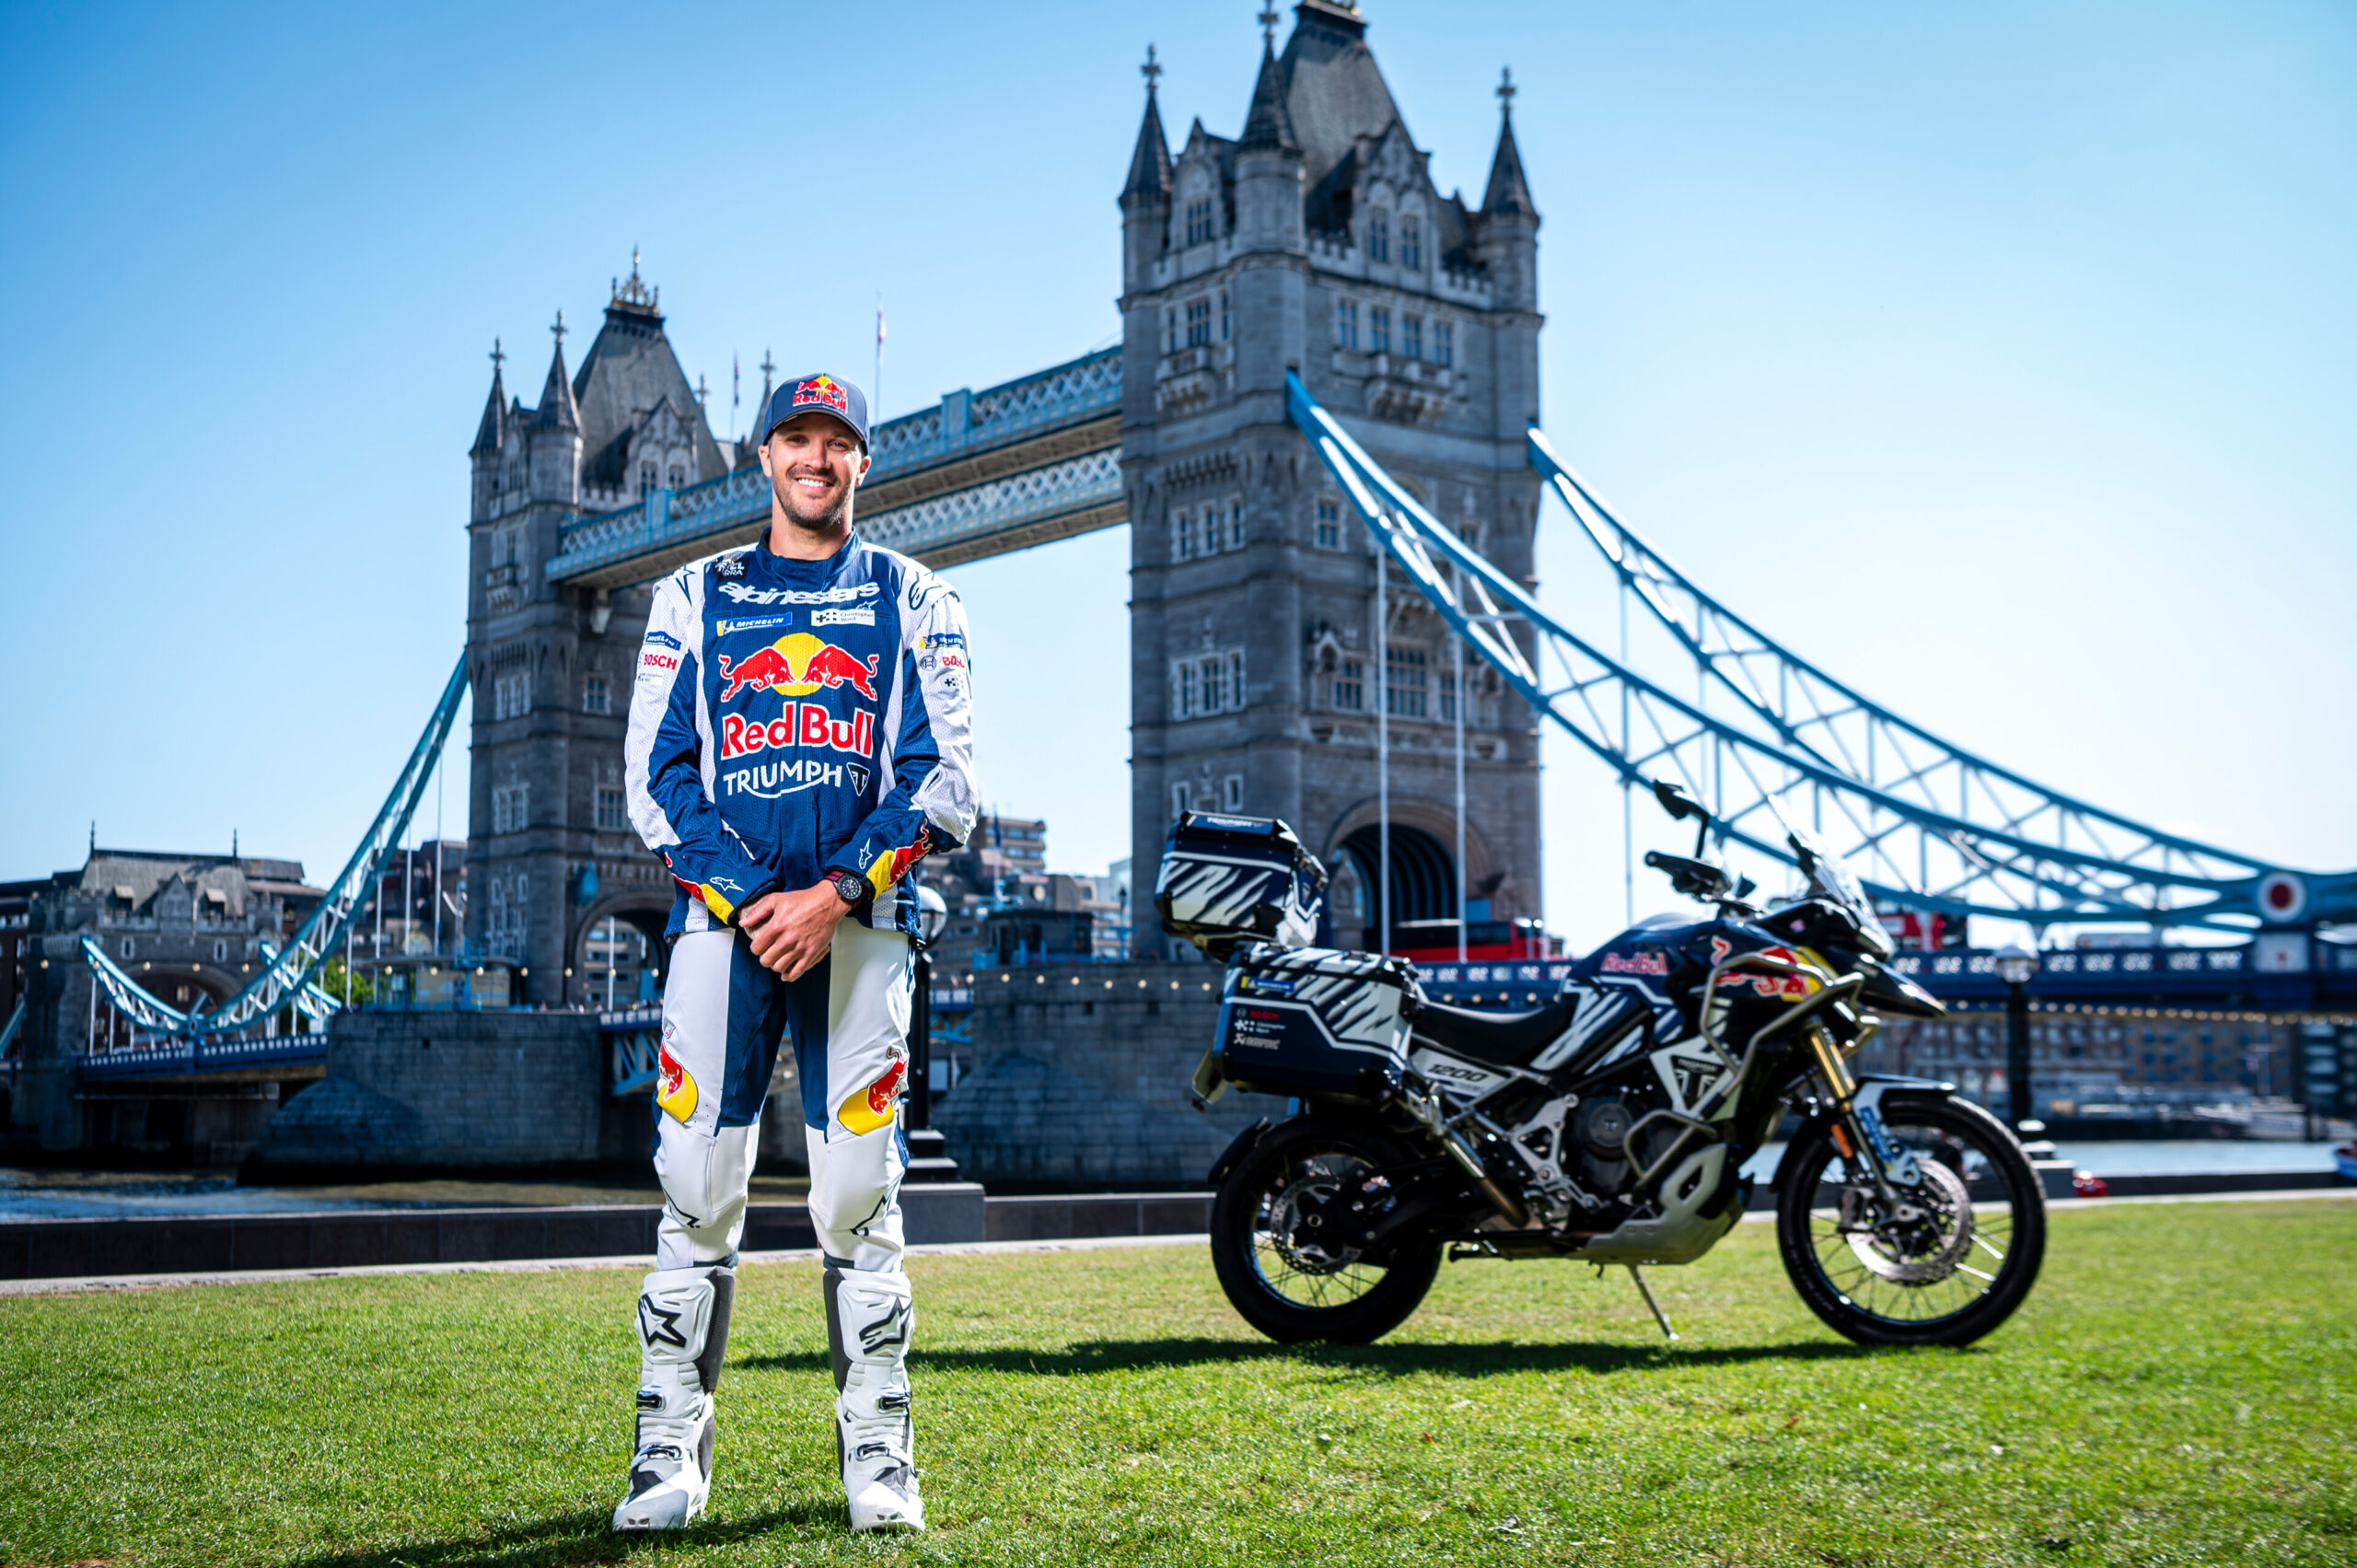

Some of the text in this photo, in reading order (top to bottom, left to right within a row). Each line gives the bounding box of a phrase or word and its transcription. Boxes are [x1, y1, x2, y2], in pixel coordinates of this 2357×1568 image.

[793, 391, 848, 413] Red Bull
[719, 582, 880, 605] alpinestars
[737, 618, 784, 628] MICHELIN
[644, 654, 678, 670] BOSCH
[942, 655, 965, 668] BOSC
[722, 702, 876, 760] Red Bull
[723, 760, 842, 798] TRIUMPH
[1600, 952, 1669, 975] Red Bull
[1249, 1010, 1280, 1020] BOSCH
[1427, 1064, 1489, 1082] 1200
